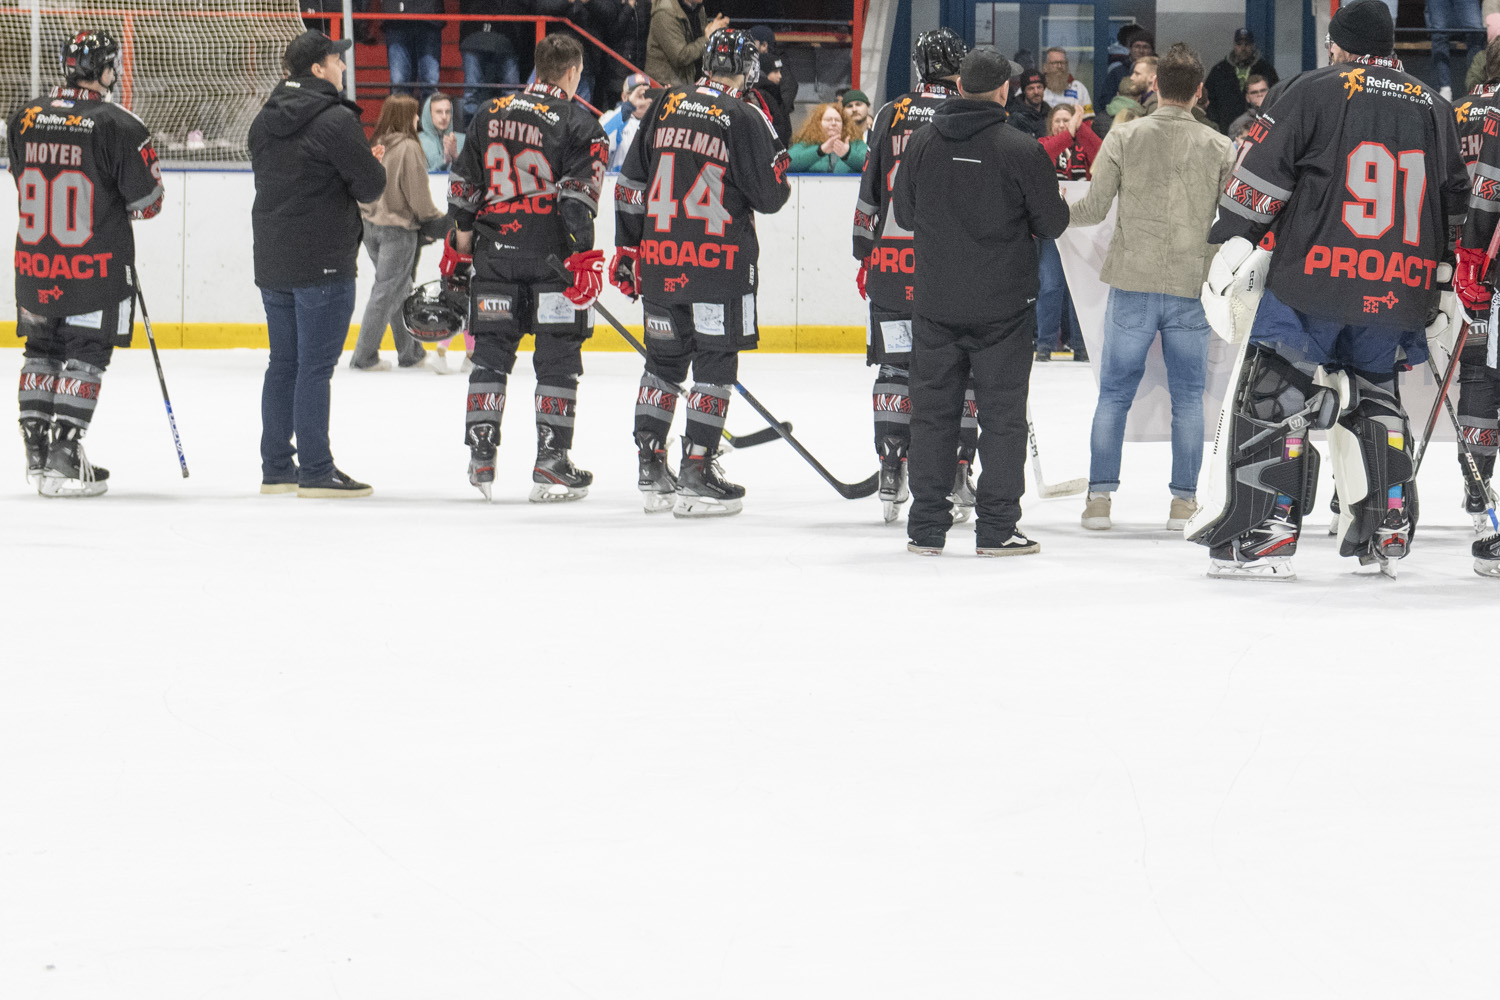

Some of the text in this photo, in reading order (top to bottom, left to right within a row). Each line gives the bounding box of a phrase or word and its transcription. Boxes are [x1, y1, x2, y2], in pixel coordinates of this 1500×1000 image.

[1366, 87, 1380, 96] Wir
[1381, 89, 1408, 101] geben
[36, 113, 95, 129] Reifen24.de
[25, 142, 83, 166] MOYER
[484, 142, 555, 205] 30
[18, 166, 94, 248] 90
[647, 152, 732, 238] 44
[1342, 140, 1428, 248] 91
[1303, 244, 1438, 290] PROACT
[484, 298, 511, 312] KTM
[1027, 421, 1040, 458] CCM
